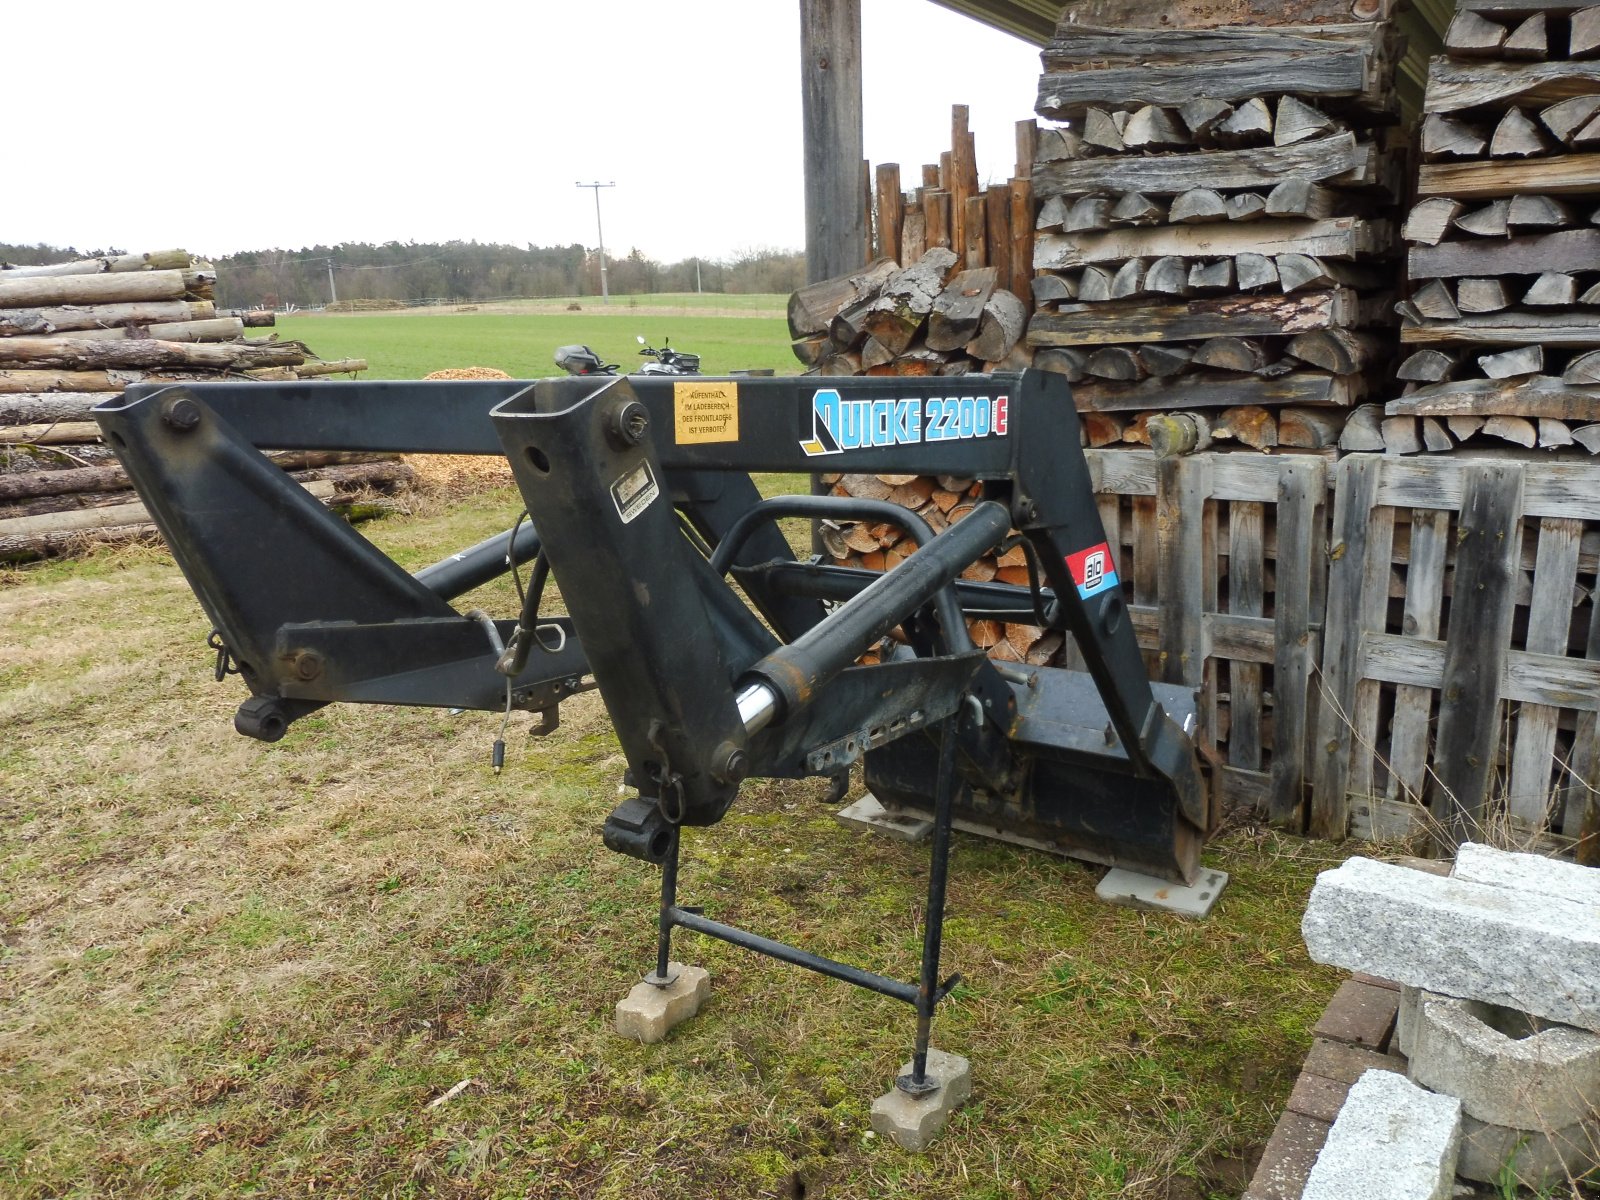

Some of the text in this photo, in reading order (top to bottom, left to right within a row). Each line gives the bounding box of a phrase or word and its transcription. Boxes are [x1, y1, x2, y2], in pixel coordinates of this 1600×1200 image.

[690, 391, 726, 399] AUFENTHAL
[800, 389, 990, 456] QUICKE 2200
[996, 396, 1008, 436] E
[626, 491, 656, 518] SWEDEN
